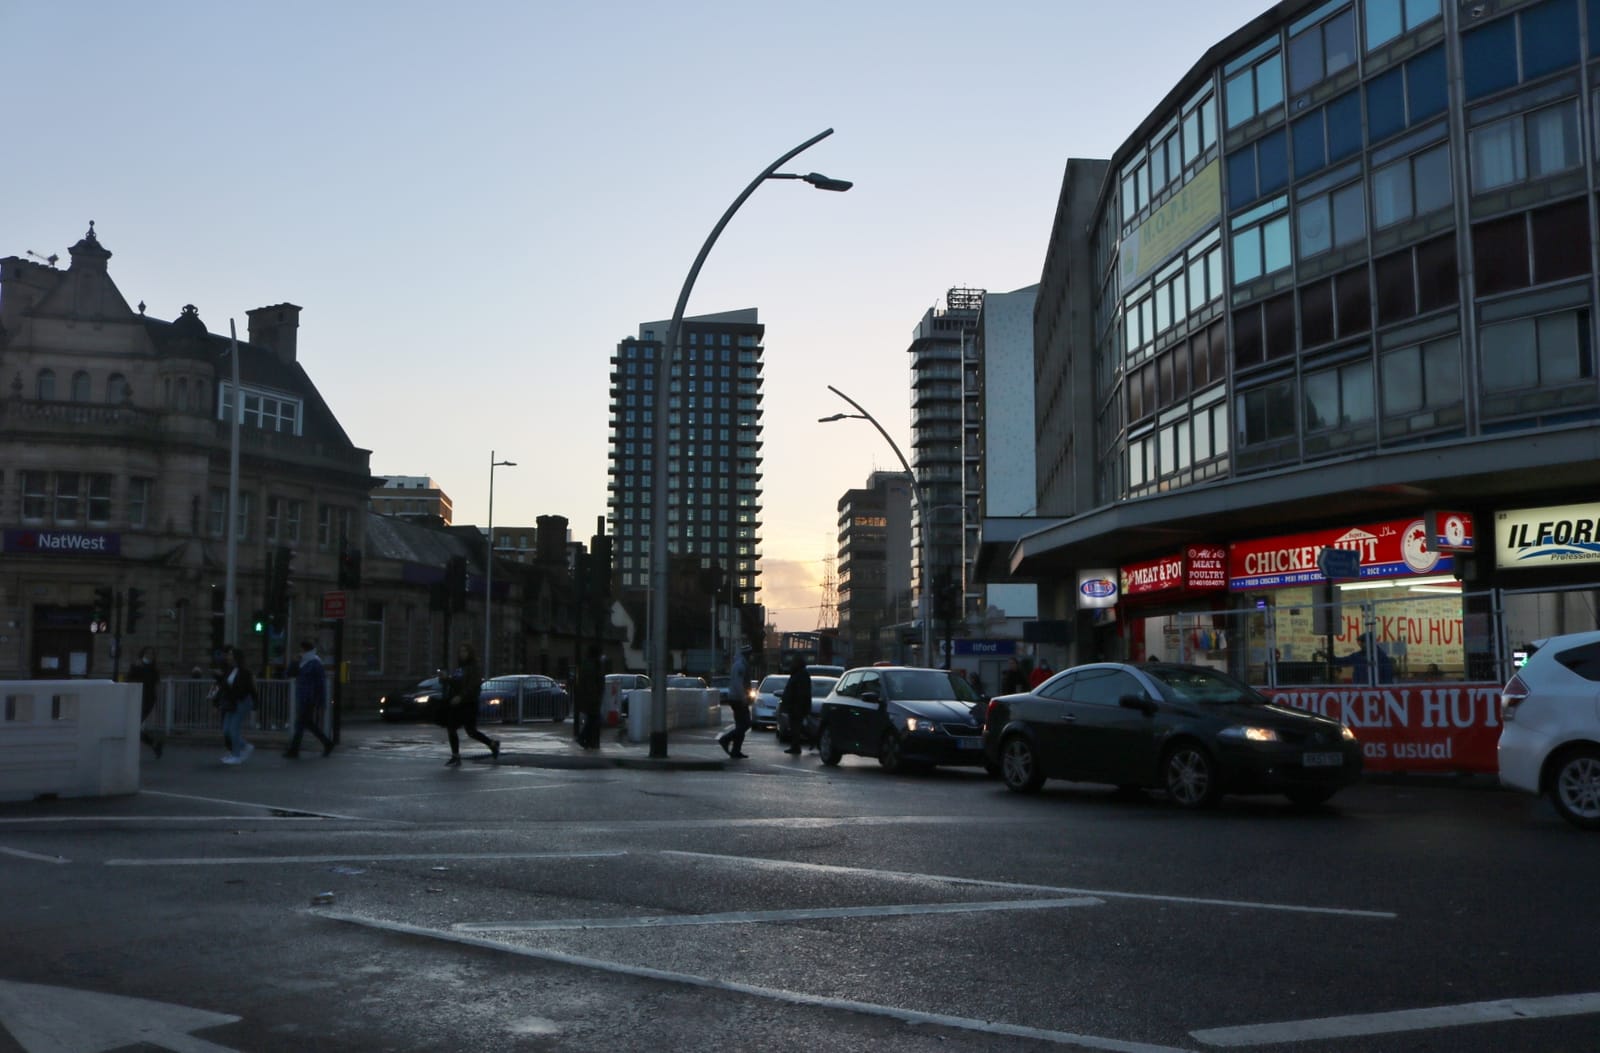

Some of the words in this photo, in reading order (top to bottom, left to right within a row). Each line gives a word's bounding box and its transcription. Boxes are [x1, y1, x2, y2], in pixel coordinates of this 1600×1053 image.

[39, 534, 105, 550] NatWest
[1192, 560, 1215, 568] MEAT
[1215, 560, 1222, 568] &
[1135, 565, 1159, 585] MEAT
[1159, 563, 1166, 581] &
[1189, 571, 1225, 579] POULTRY
[972, 643, 998, 652] Ilford
[1421, 688, 1504, 728] HUT
[1363, 743, 1387, 758] as
[1393, 738, 1452, 759] usual
